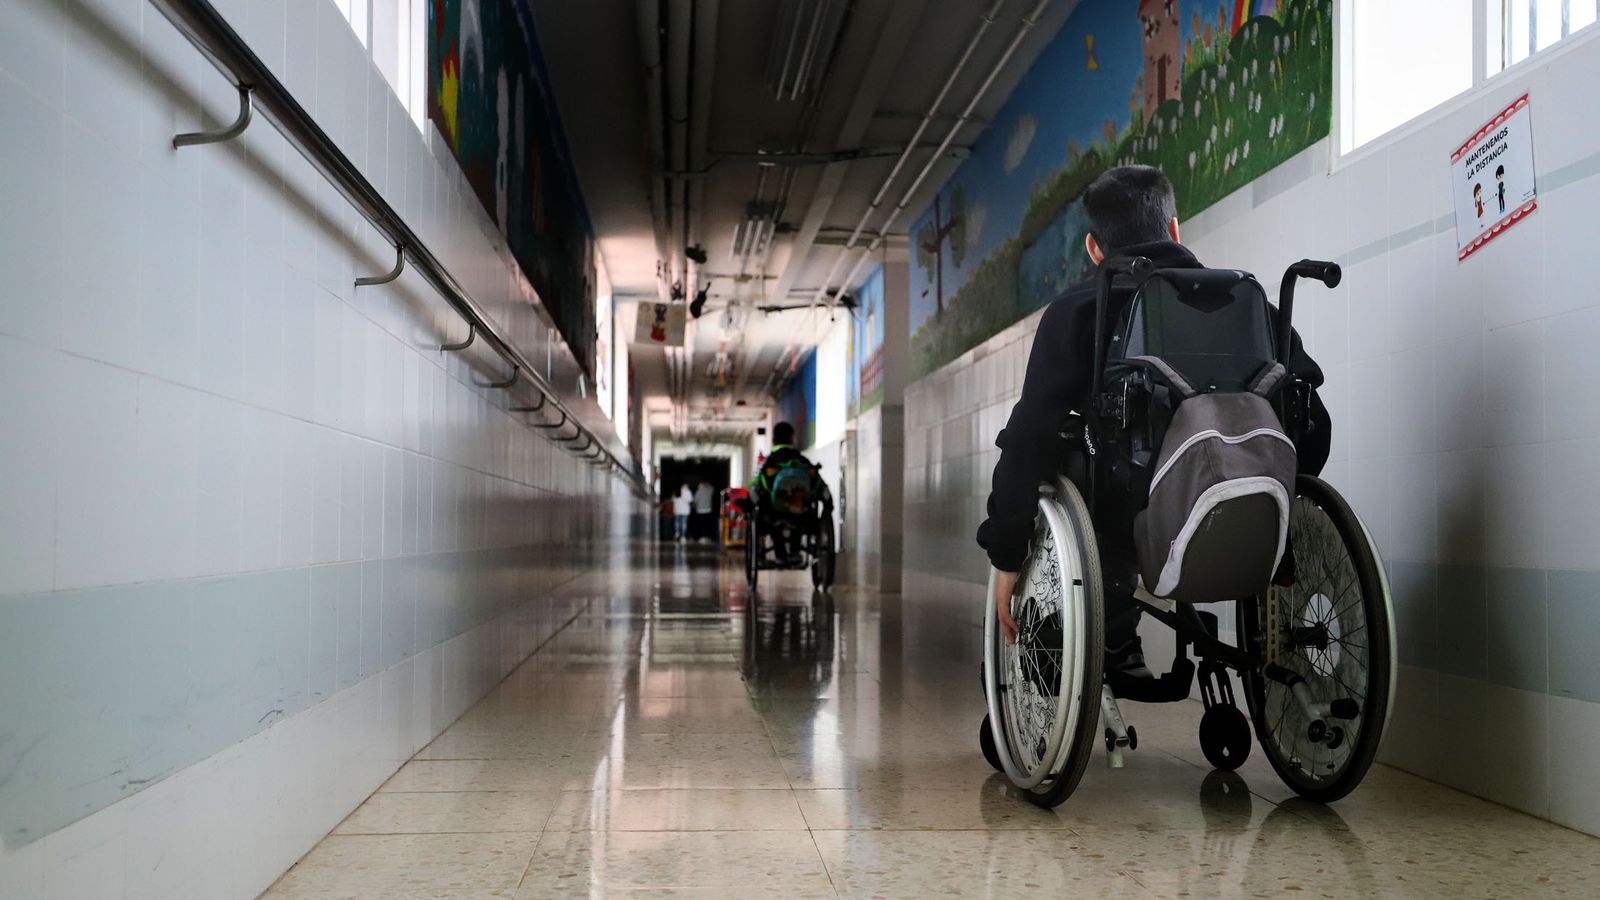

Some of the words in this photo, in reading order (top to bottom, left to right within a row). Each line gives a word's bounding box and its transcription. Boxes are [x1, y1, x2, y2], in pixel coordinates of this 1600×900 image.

[1465, 126, 1508, 168] MANTENEMOS
[1467, 168, 1475, 180] LA
[1475, 141, 1508, 173] DISTANCIA
